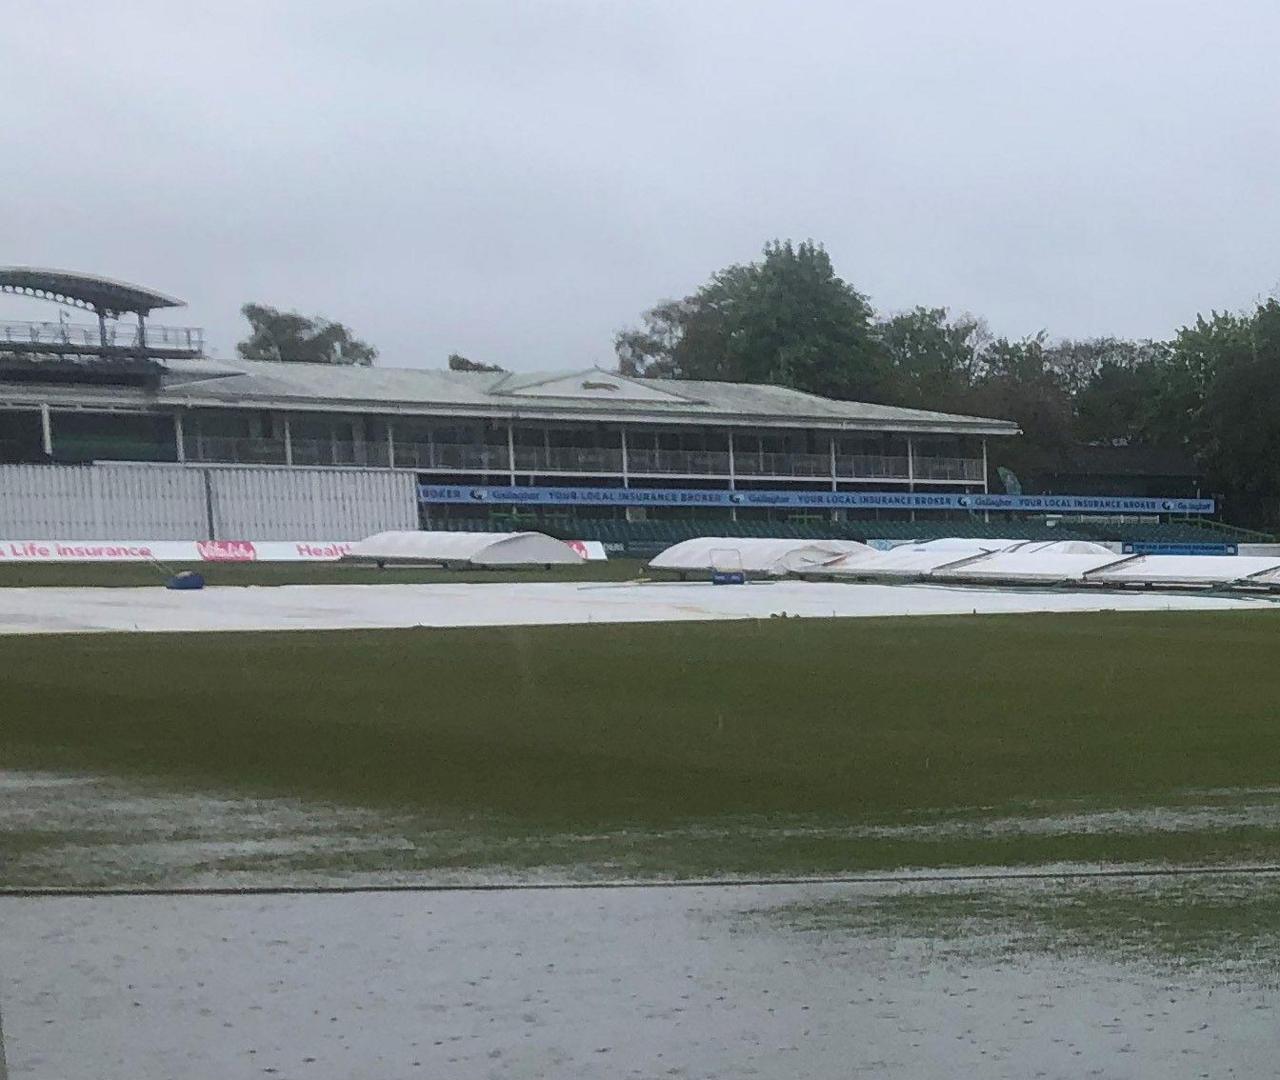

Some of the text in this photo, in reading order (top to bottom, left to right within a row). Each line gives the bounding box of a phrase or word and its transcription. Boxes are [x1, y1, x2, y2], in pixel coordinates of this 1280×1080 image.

[580, 491, 613, 500] LOCAL
[618, 492, 679, 501] INSURANCE
[681, 493, 721, 502] BROKER
[798, 495, 953, 506] YOUR LOCAL INSURANCE BROKER
[1019, 499, 1157, 510] YOUR LOCAL INSURANCE BROKER
[296, 543, 352, 557] Healt
